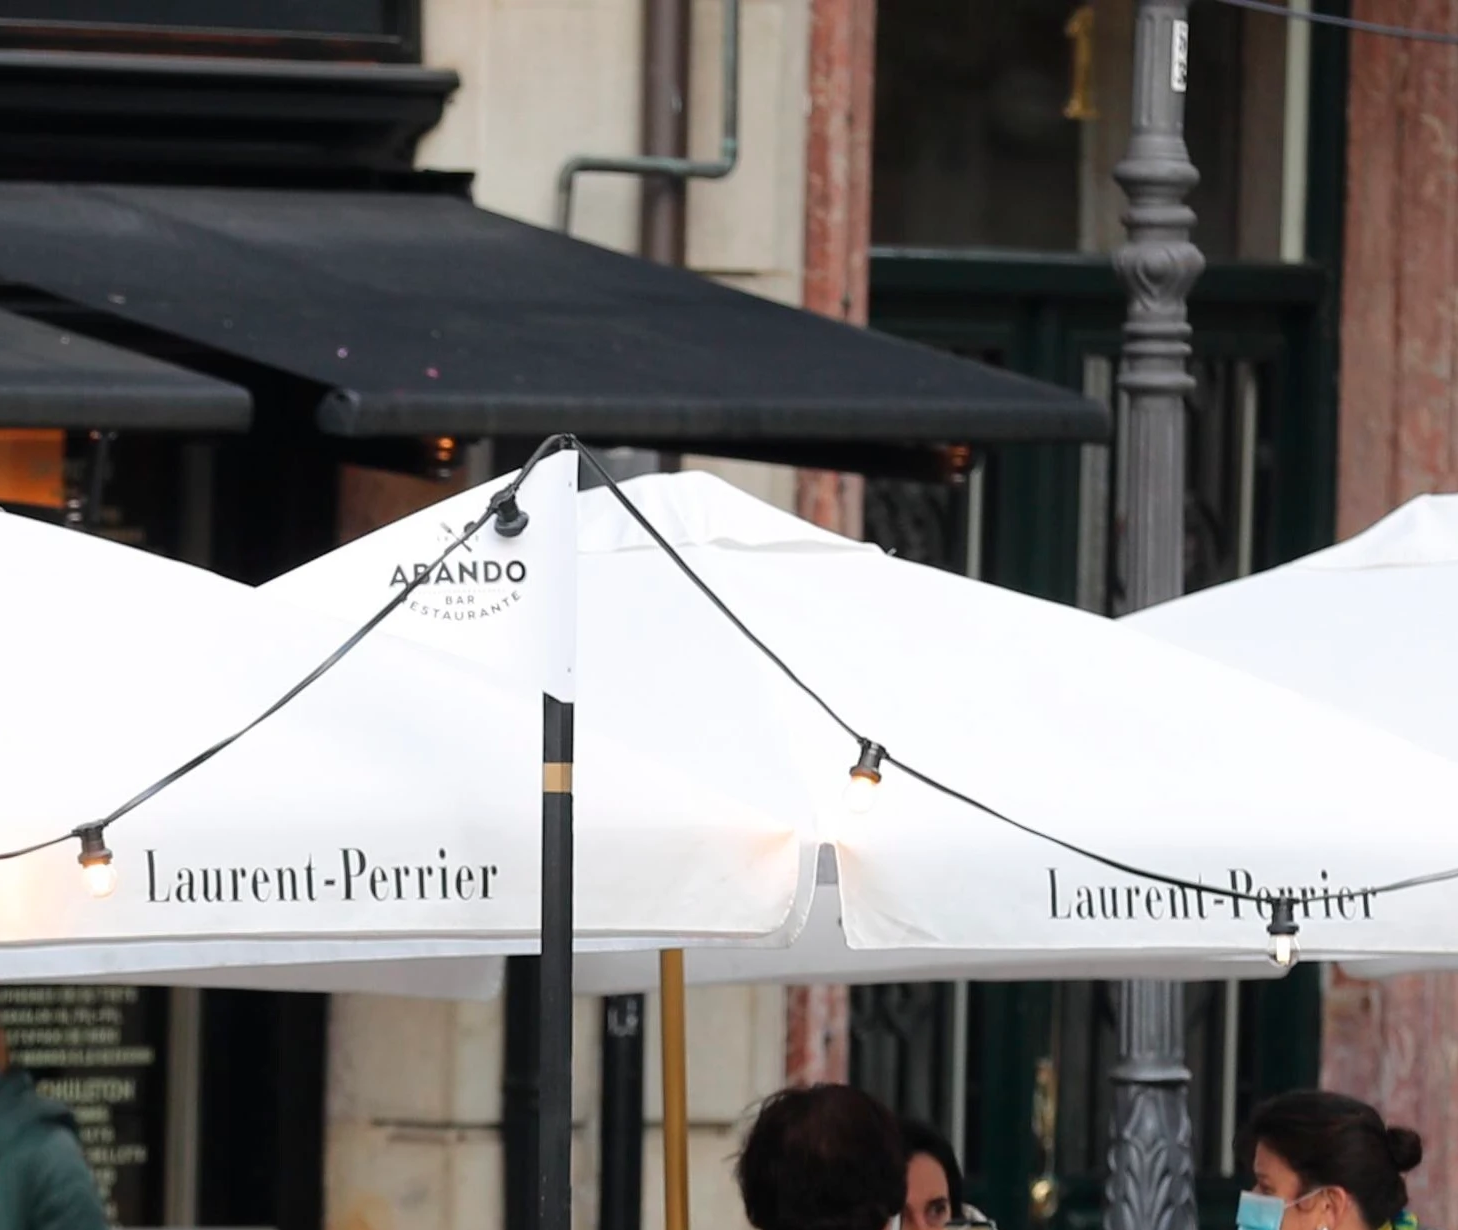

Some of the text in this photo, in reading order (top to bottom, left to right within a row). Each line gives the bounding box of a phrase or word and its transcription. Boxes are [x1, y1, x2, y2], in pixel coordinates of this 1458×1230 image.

[389, 559, 527, 588] ABANDO
[407, 590, 522, 622] ESTAURANTE
[445, 595, 475, 605] BAR
[143, 847, 498, 902] Laurent-Perrier
